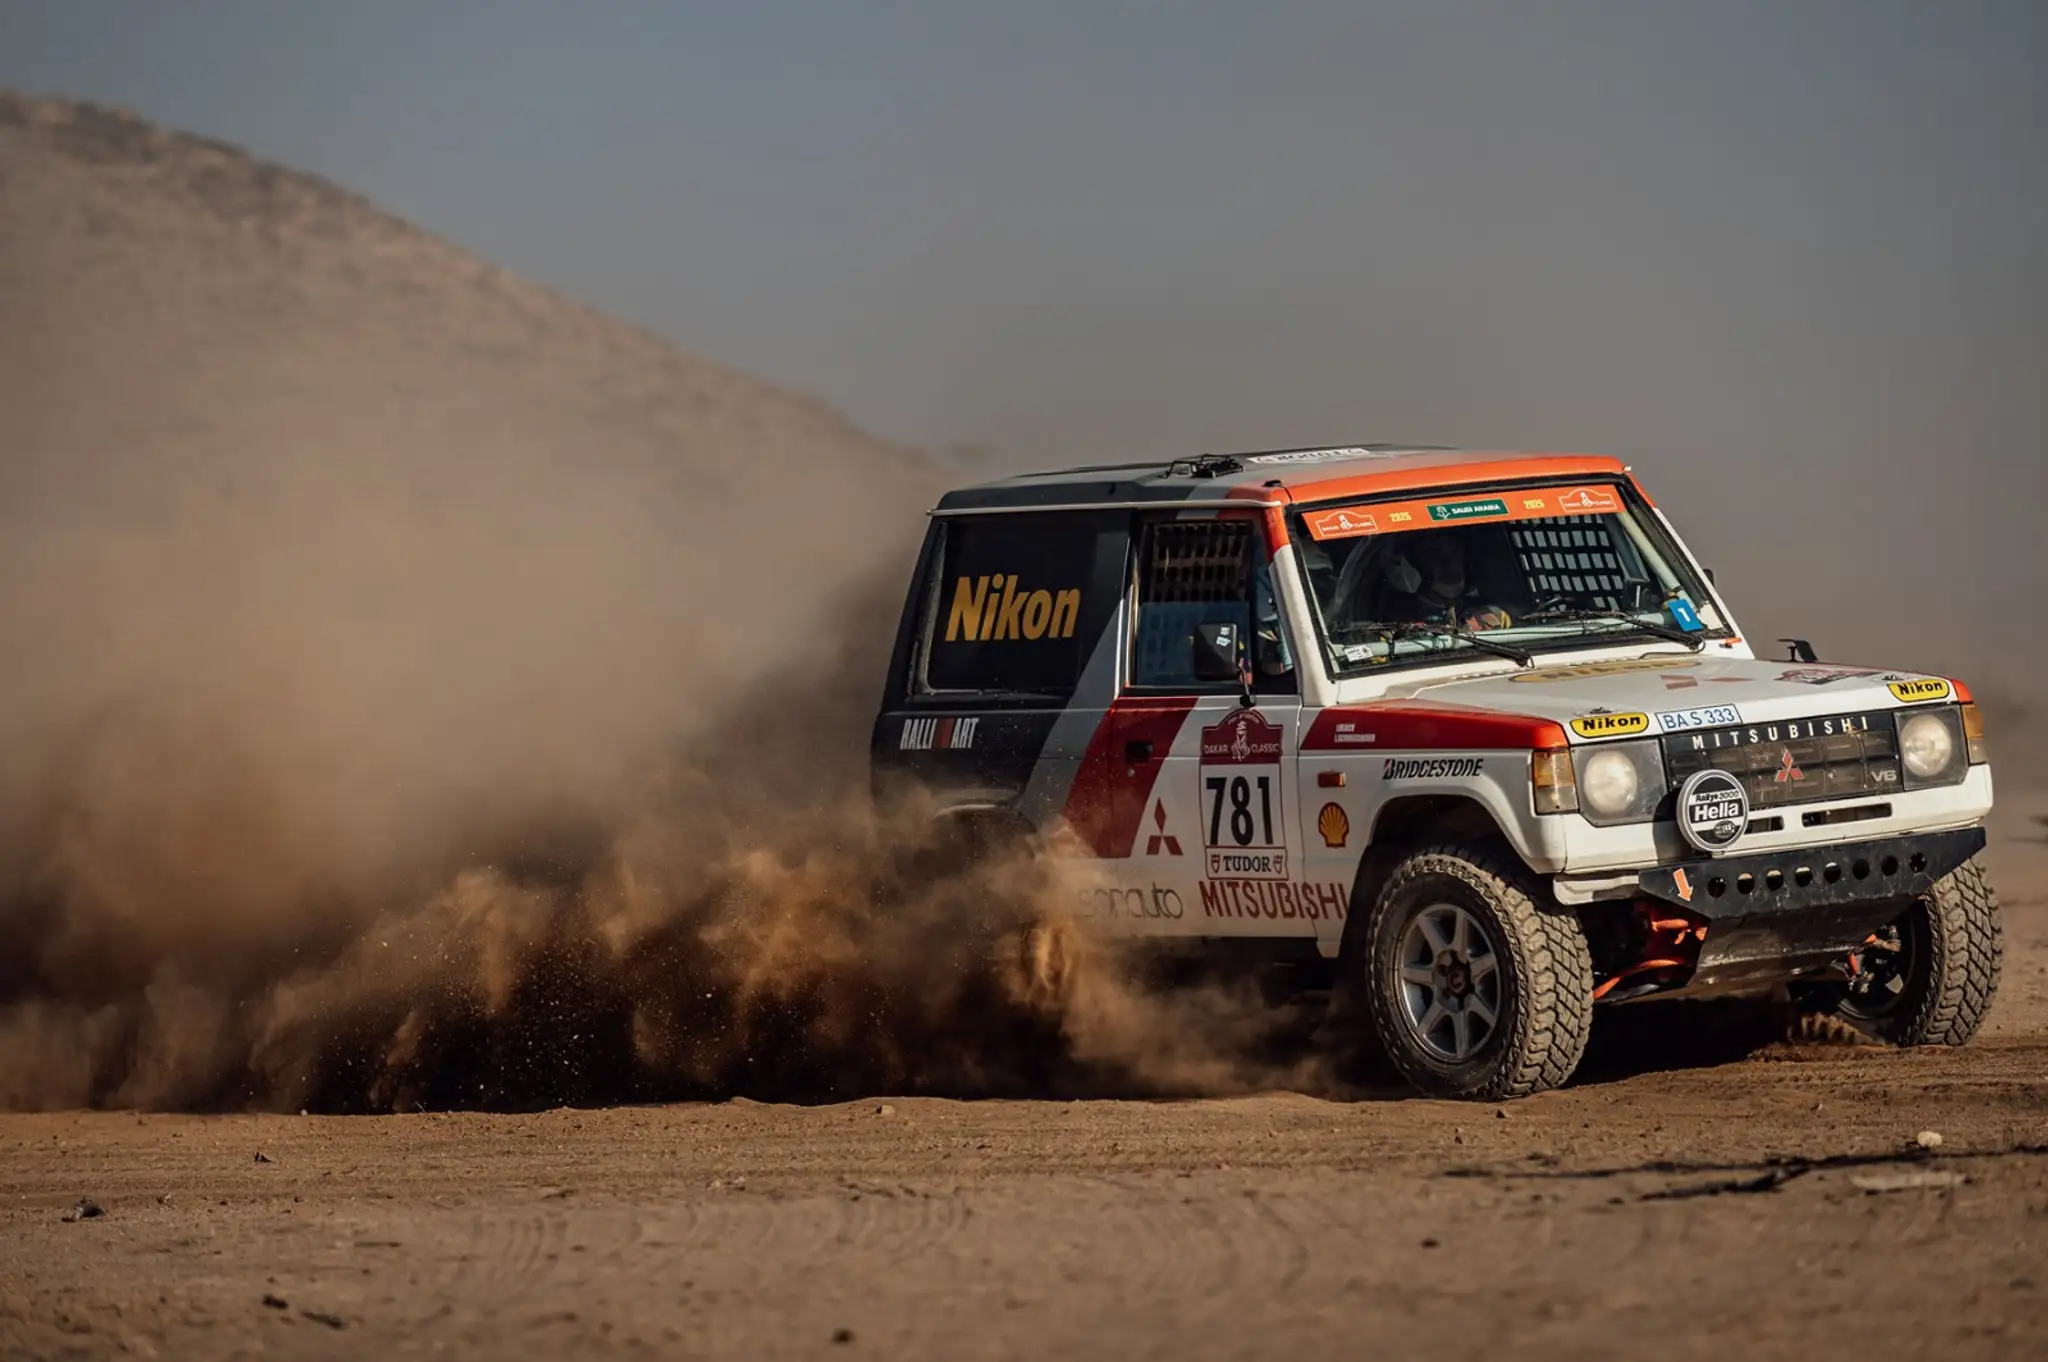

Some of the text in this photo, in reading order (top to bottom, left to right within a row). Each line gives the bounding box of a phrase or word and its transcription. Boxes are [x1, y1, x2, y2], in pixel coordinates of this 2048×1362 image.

[944, 573, 1080, 641] Nikon
[1677, 607, 1691, 622] 1
[1898, 682, 1943, 695] Nikon
[1583, 716, 1641, 731] Nikon
[1704, 707, 1735, 724] 333
[1692, 716, 1868, 750] MITSUBISHI
[1204, 743, 1279, 754] DAKAR CLASSIC
[1383, 758, 1484, 780] BRIDGESTONE
[1871, 771, 1897, 782] V6
[1695, 793, 1718, 802] Rallye
[1206, 776, 1273, 846] 781
[1694, 801, 1739, 821] Hella
[1223, 855, 1272, 872] TUDOR
[1198, 880, 1348, 920] MITSUBISHI
